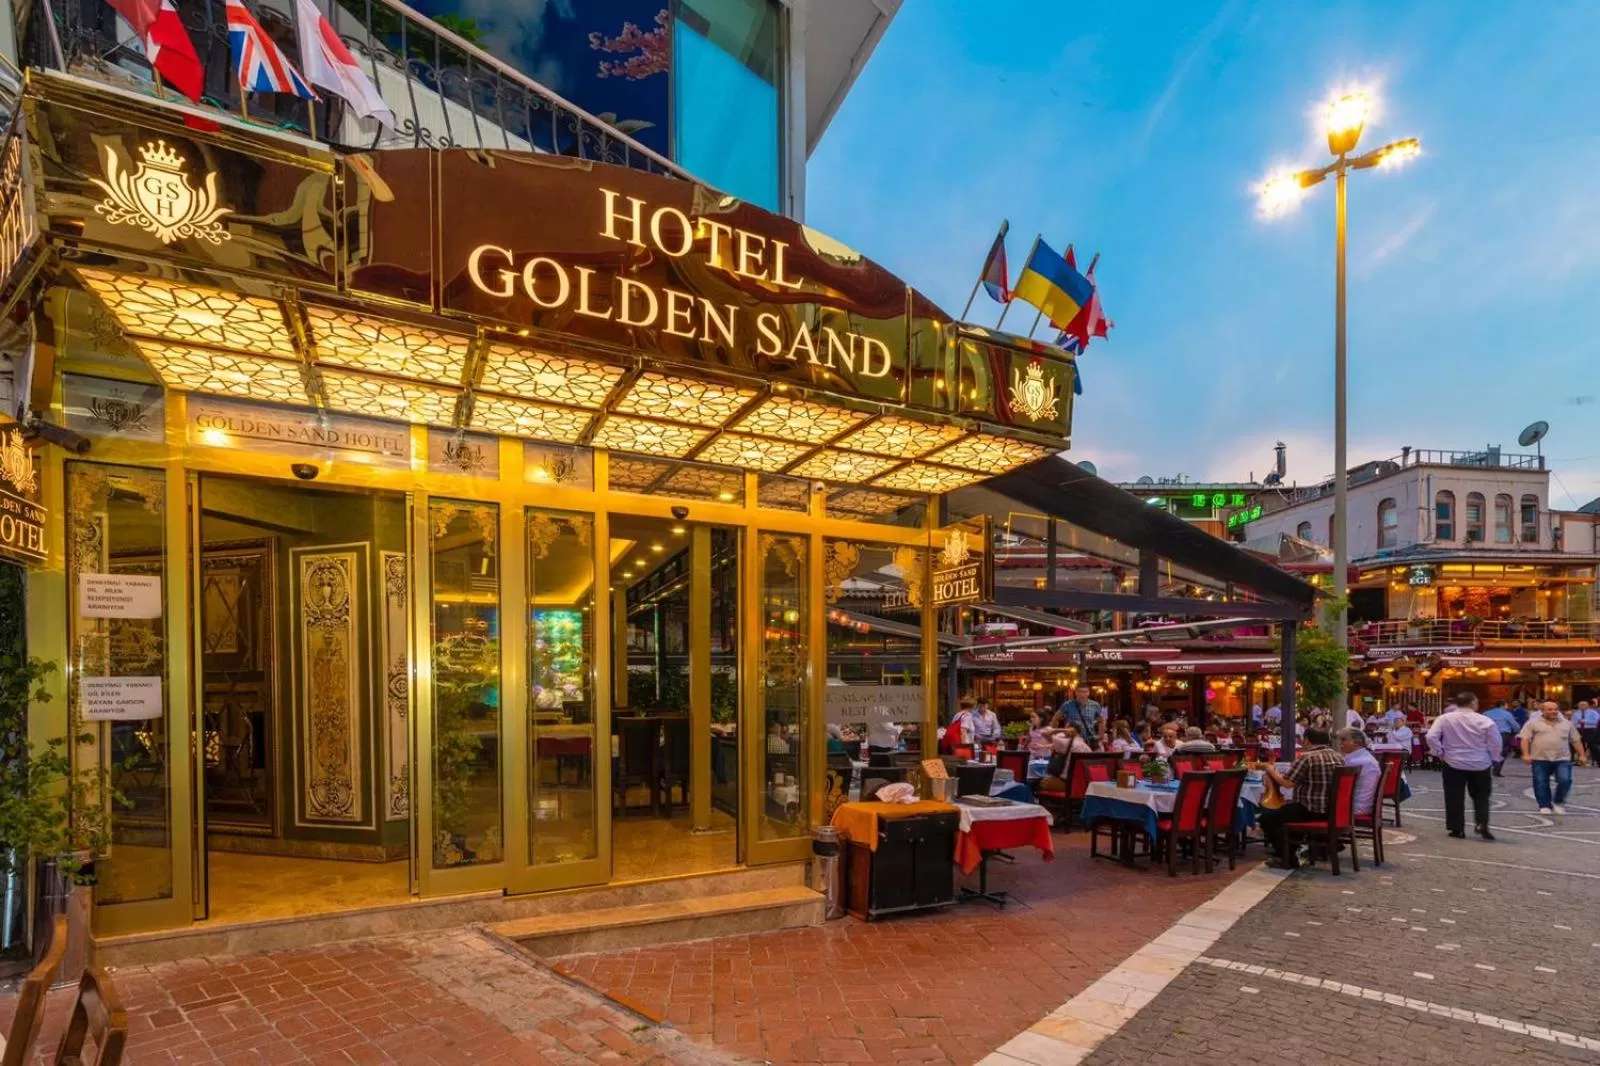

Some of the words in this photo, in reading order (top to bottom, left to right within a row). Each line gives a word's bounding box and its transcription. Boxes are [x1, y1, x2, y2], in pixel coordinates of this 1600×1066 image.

[599, 187, 804, 289] HOTEL
[467, 243, 740, 348] GOLDEN
[755, 311, 892, 378] SAND
[195, 413, 281, 437] GOLDEN
[287, 422, 339, 444] SAND
[344, 432, 404, 452] HOTEL
[1192, 493, 1245, 507] EGE
[24, 506, 46, 524] SAND
[934, 577, 980, 601] HOTEL
[1104, 651, 1123, 661] EGE
